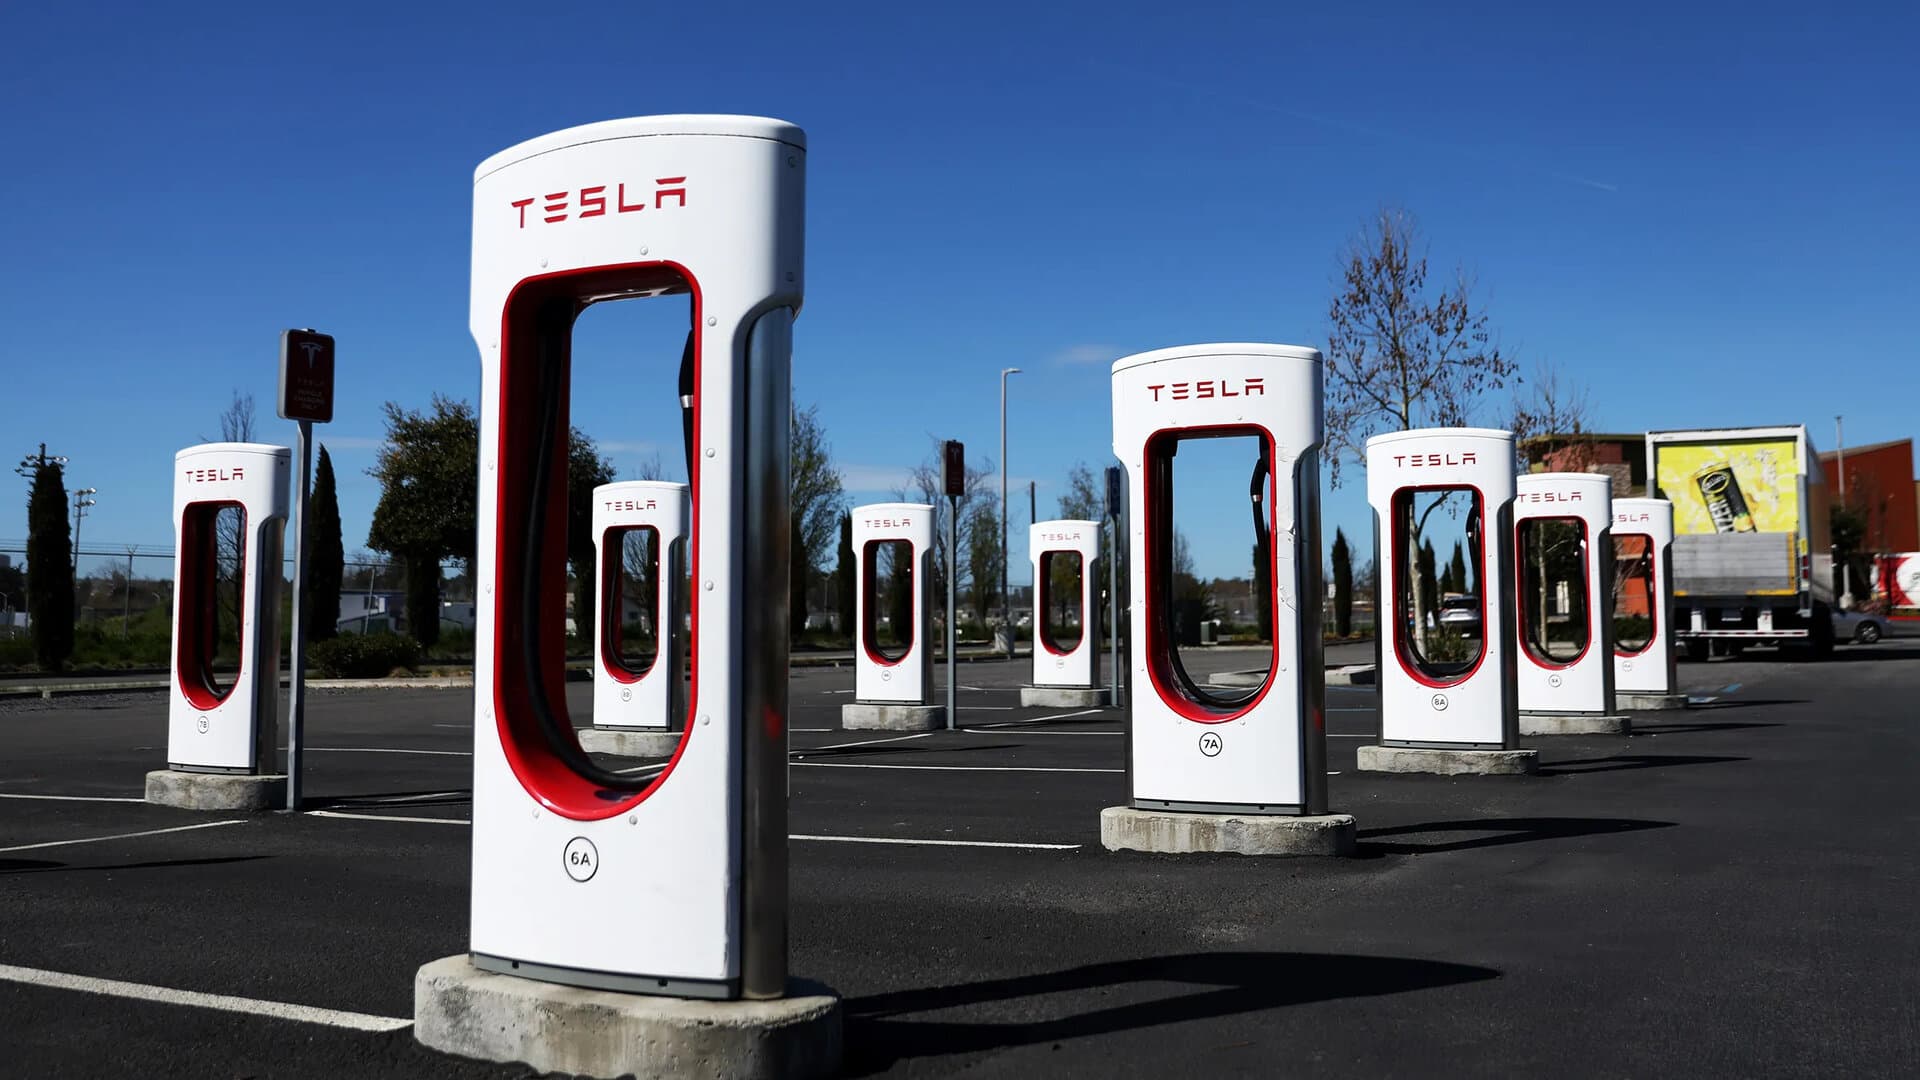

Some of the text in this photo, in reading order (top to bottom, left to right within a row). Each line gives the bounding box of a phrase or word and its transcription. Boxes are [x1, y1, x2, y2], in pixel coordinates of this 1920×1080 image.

[511, 176, 687, 229] TESLA
[1147, 377, 1264, 402] TESLA
[1394, 452, 1476, 468] TESLA
[185, 467, 243, 483] TESLA
[1517, 491, 1582, 503] TESLA
[605, 500, 656, 512] TESLA
[865, 518, 911, 528] TESLA
[1612, 513, 1650, 523] SLA
[1041, 532, 1081, 542] TESLA
[1203, 739, 1219, 749] 7A
[571, 851, 591, 866] 6A
